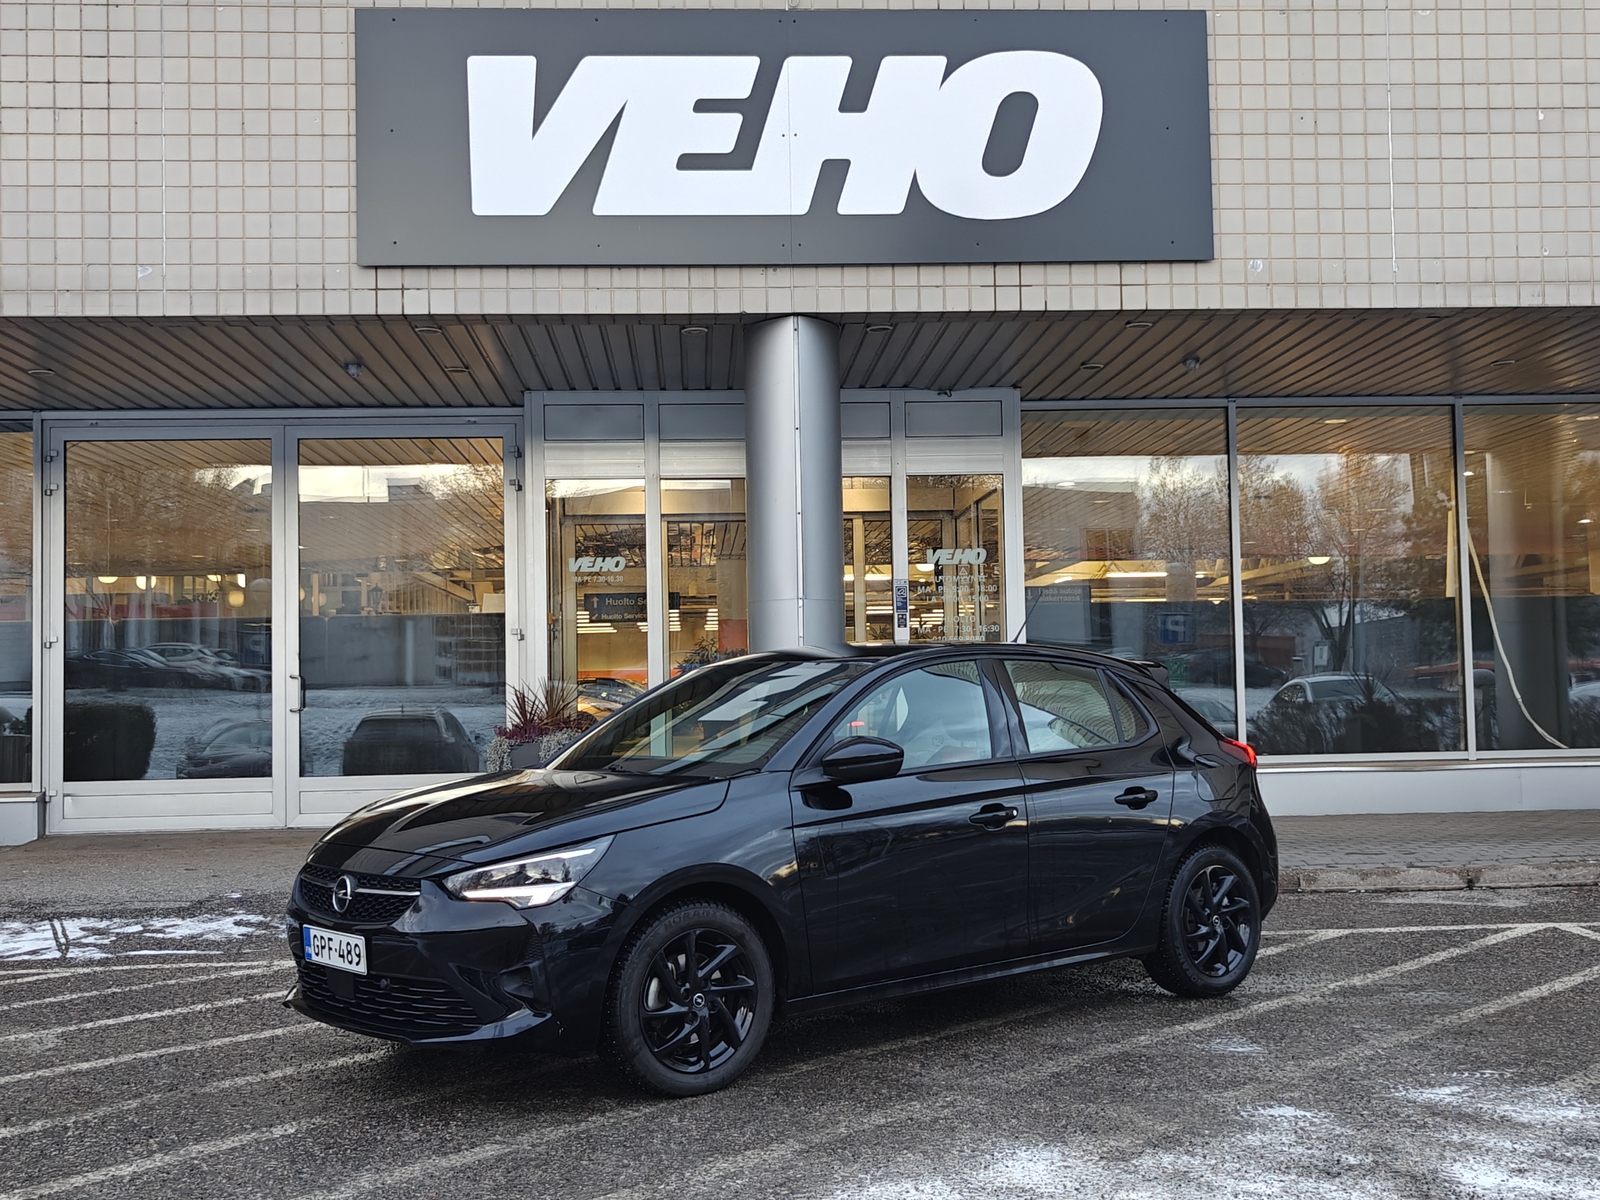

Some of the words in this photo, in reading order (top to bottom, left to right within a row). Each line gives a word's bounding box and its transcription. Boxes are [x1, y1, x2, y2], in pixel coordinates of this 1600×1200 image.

[467, 50, 1103, 220] VEHO
[568, 556, 626, 573] VEHO
[926, 548, 987, 565] VEHO
[605, 597, 635, 606] Huolto
[312, 934, 362, 967] GPF-489
